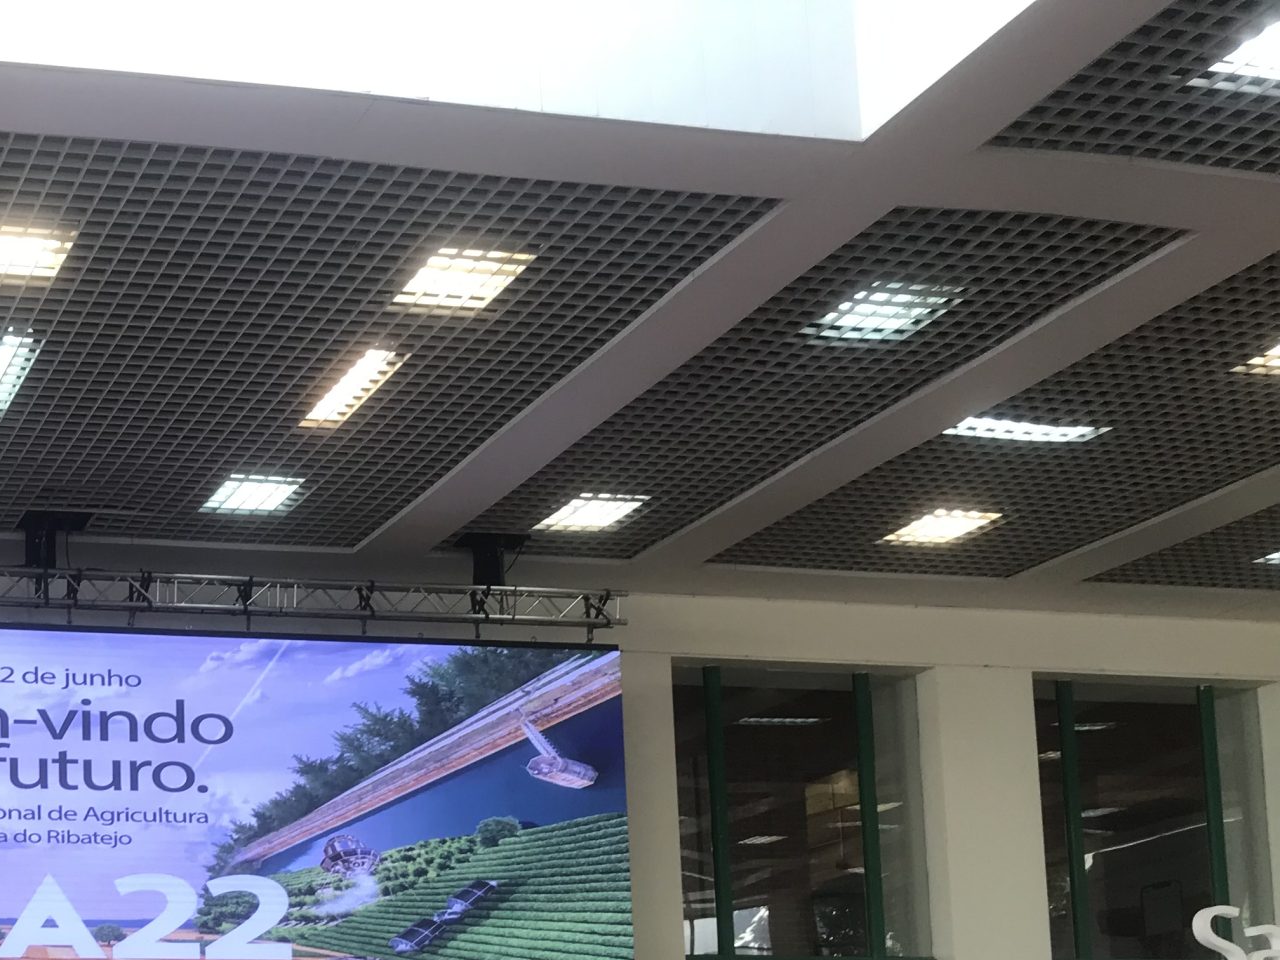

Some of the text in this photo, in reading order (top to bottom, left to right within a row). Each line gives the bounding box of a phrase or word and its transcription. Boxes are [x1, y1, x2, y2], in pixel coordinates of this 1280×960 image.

[22, 666, 56, 685] de
[61, 668, 142, 690] junho
[48, 804, 78, 822] de
[83, 805, 209, 826] Agricultura
[13, 828, 42, 844] do
[47, 829, 132, 849] Ribatejo
